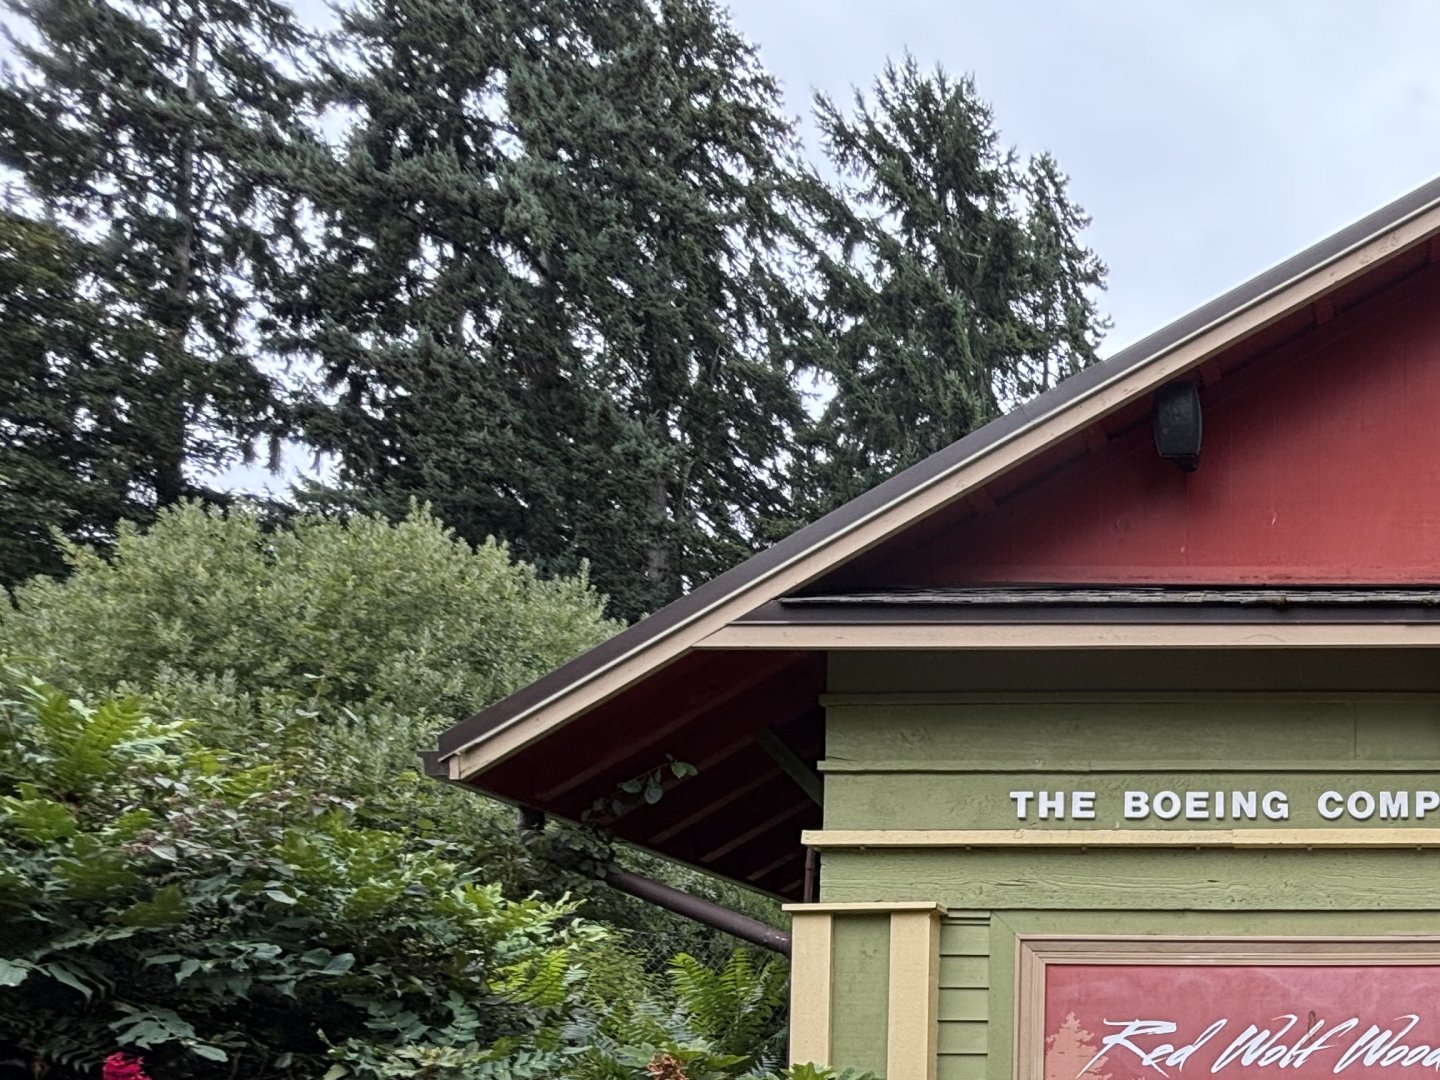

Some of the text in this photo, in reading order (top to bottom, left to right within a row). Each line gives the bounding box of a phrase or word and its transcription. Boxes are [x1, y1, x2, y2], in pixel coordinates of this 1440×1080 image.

[1009, 790, 1096, 820] THE
[1122, 790, 1290, 820] BOEING
[1076, 1017, 1228, 1078] Red
[1210, 1013, 1360, 1074] Wolf
